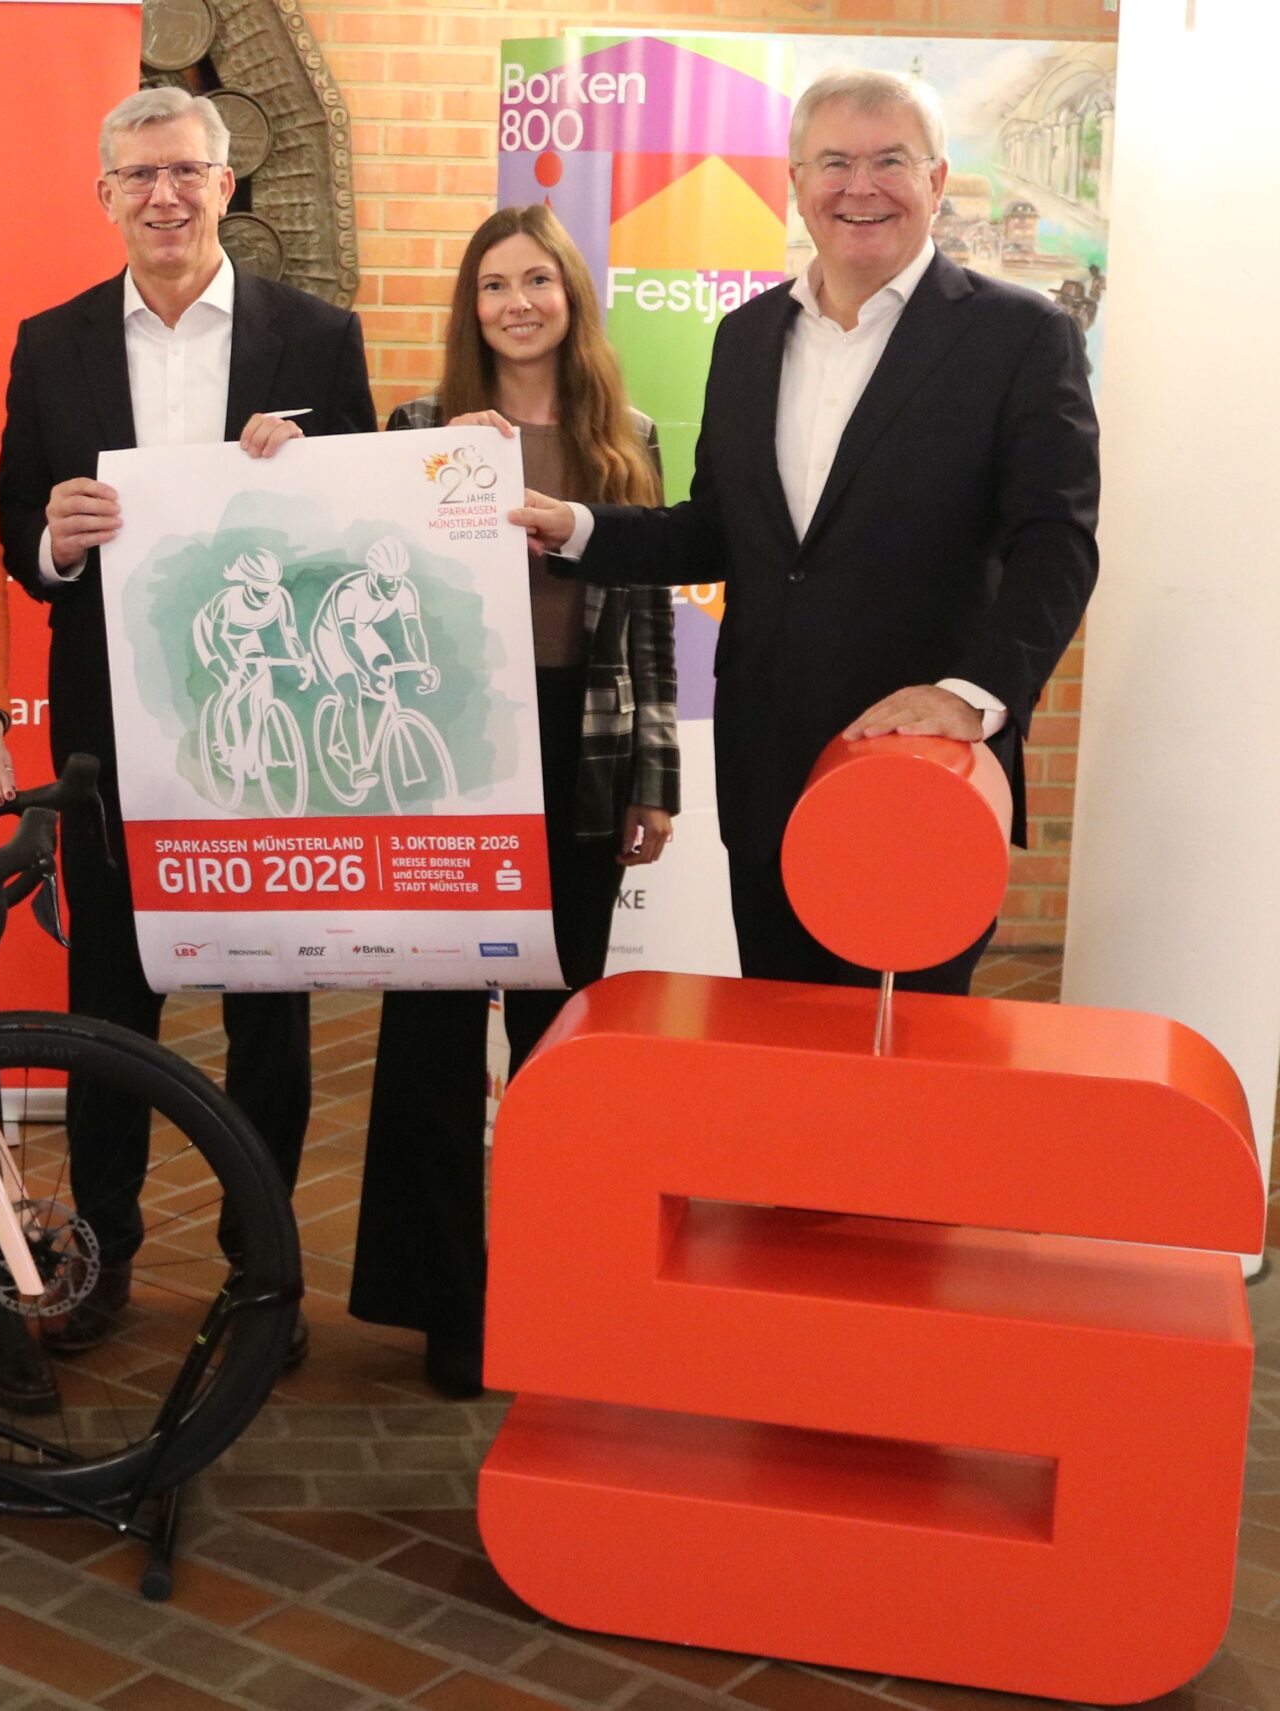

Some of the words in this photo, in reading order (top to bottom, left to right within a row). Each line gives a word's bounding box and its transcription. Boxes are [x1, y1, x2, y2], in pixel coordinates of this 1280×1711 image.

[502, 62, 647, 105] Borken
[500, 108, 585, 152] 800
[606, 266, 780, 324] Festjah
[465, 492, 497, 504] JAHRE
[437, 505, 497, 517] SPARKASSEN
[428, 517, 498, 529] MÜNSTERLAND
[449, 530, 473, 541] GIRO
[474, 529, 499, 540] 2026
[154, 839, 248, 854] SPARKASSEN
[253, 835, 364, 852] MÜNSTERLAND
[390, 836, 405, 851] 3.
[406, 836, 477, 851] OKTOBER
[480, 835, 520, 851] 2026
[392, 857, 428, 868] KREISE
[430, 857, 471, 868] BORKEN
[158, 857, 252, 894] GIRO
[262, 854, 366, 893] 2026
[393, 869, 412, 880] und
[413, 870, 465, 881] COESFELD
[394, 881, 427, 892] STADT
[429, 880, 479, 892] MÜNSTER
[174, 947, 198, 957] LBS
[298, 946, 327, 957] ROSE
[362, 945, 397, 954] Brillux
